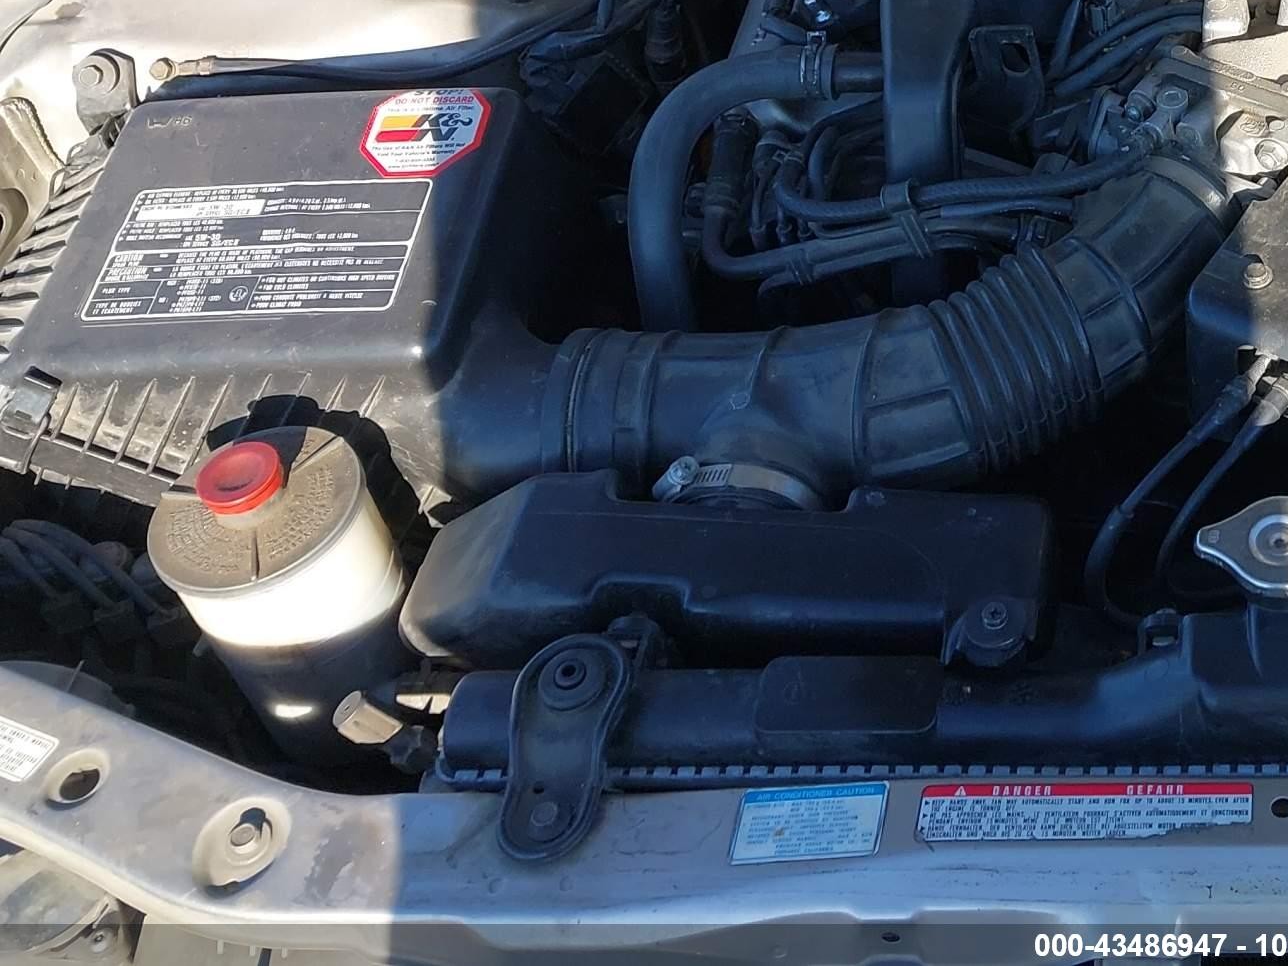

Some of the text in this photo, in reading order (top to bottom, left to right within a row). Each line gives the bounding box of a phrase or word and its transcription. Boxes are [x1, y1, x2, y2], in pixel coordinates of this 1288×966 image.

[433, 96, 475, 104] DISCARD
[774, 790, 833, 800] CONDITIONER
[837, 787, 875, 795] CAUTION
[992, 785, 1052, 796] DANGER
